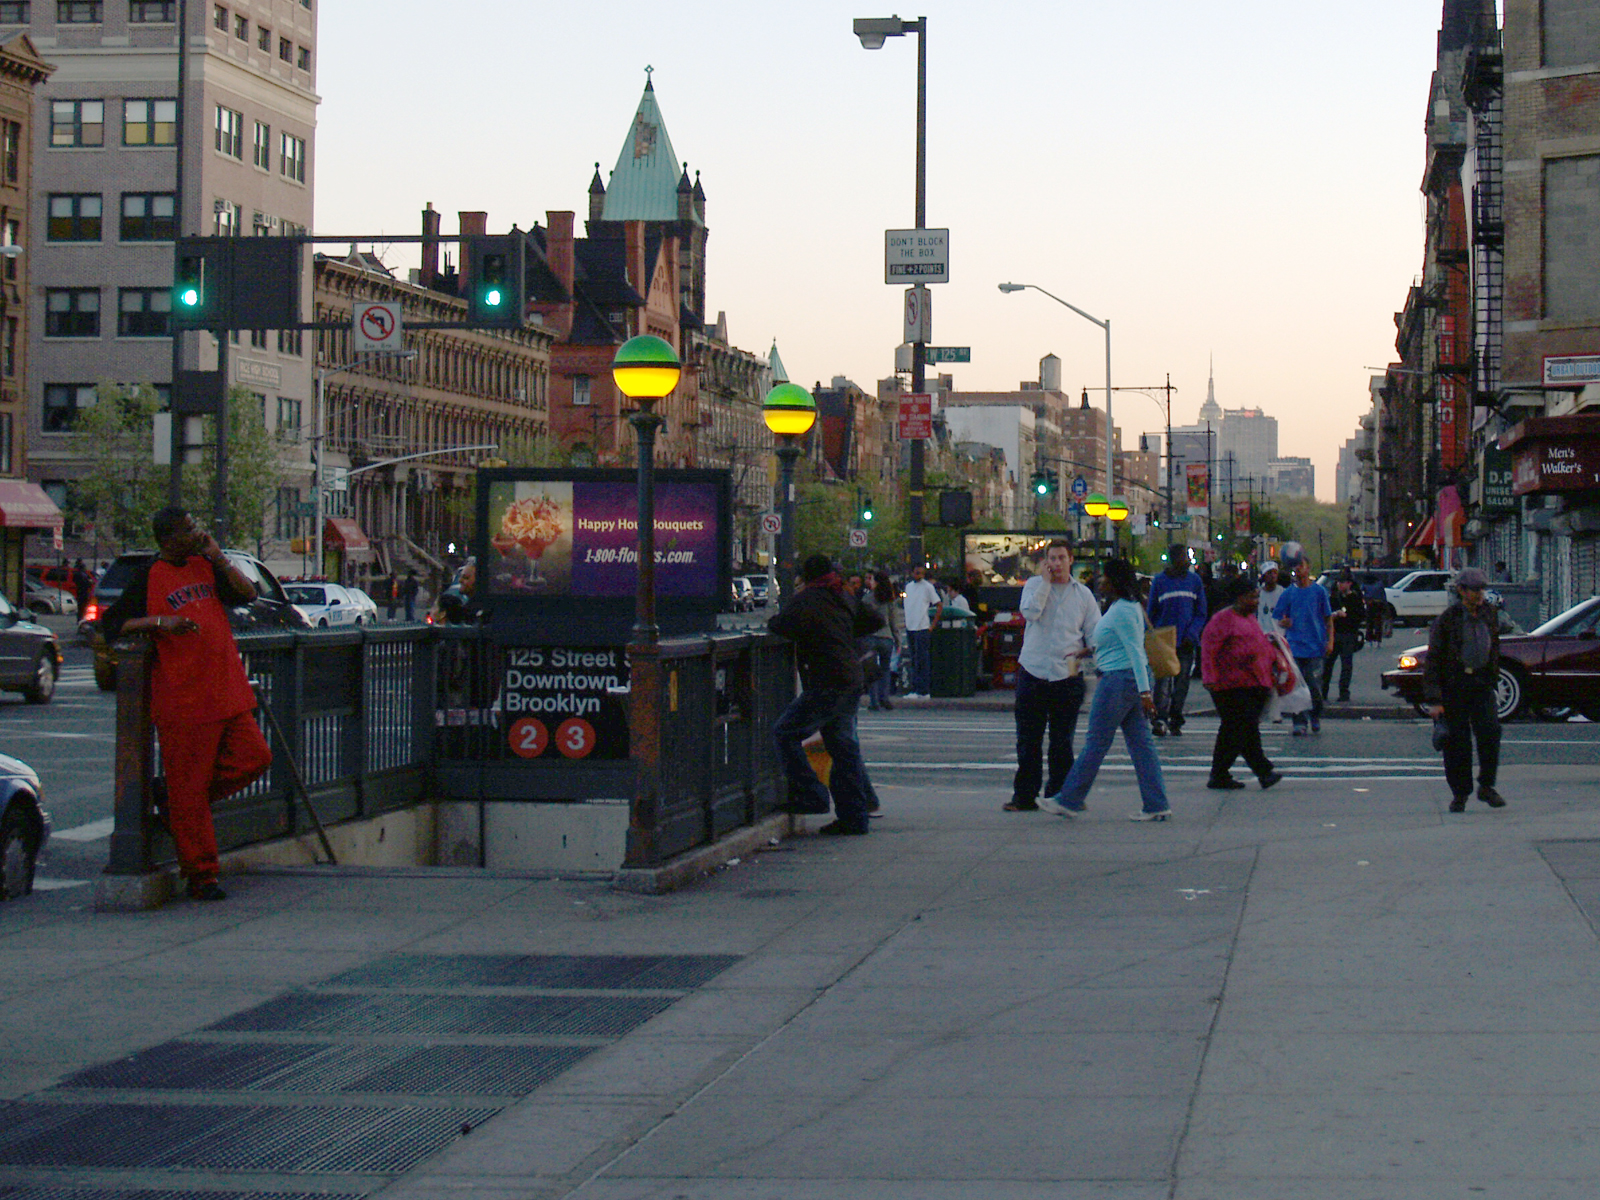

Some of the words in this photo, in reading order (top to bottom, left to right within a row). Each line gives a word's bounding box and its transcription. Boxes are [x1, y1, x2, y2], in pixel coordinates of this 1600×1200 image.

[918, 237, 944, 246] BLOCK
[900, 249, 915, 257] THE
[919, 249, 935, 257] BOX
[919, 264, 943, 274] POINTS
[930, 349, 938, 361] W
[941, 349, 957, 362] 125
[1551, 362, 1575, 376] URBAN
[1548, 447, 1575, 459] Men's
[1541, 462, 1582, 474] Walker's
[1486, 486, 1513, 496] UNISE
[1486, 496, 1515, 506] SALON
[578, 518, 615, 532] Happy
[618, 518, 640, 530] Hou
[508, 650, 543, 667] 125
[551, 649, 617, 668] Street
[506, 670, 619, 690] Downtown
[506, 692, 601, 716] Brooklyn
[520, 725, 538, 749] 2
[567, 725, 585, 750] 3
